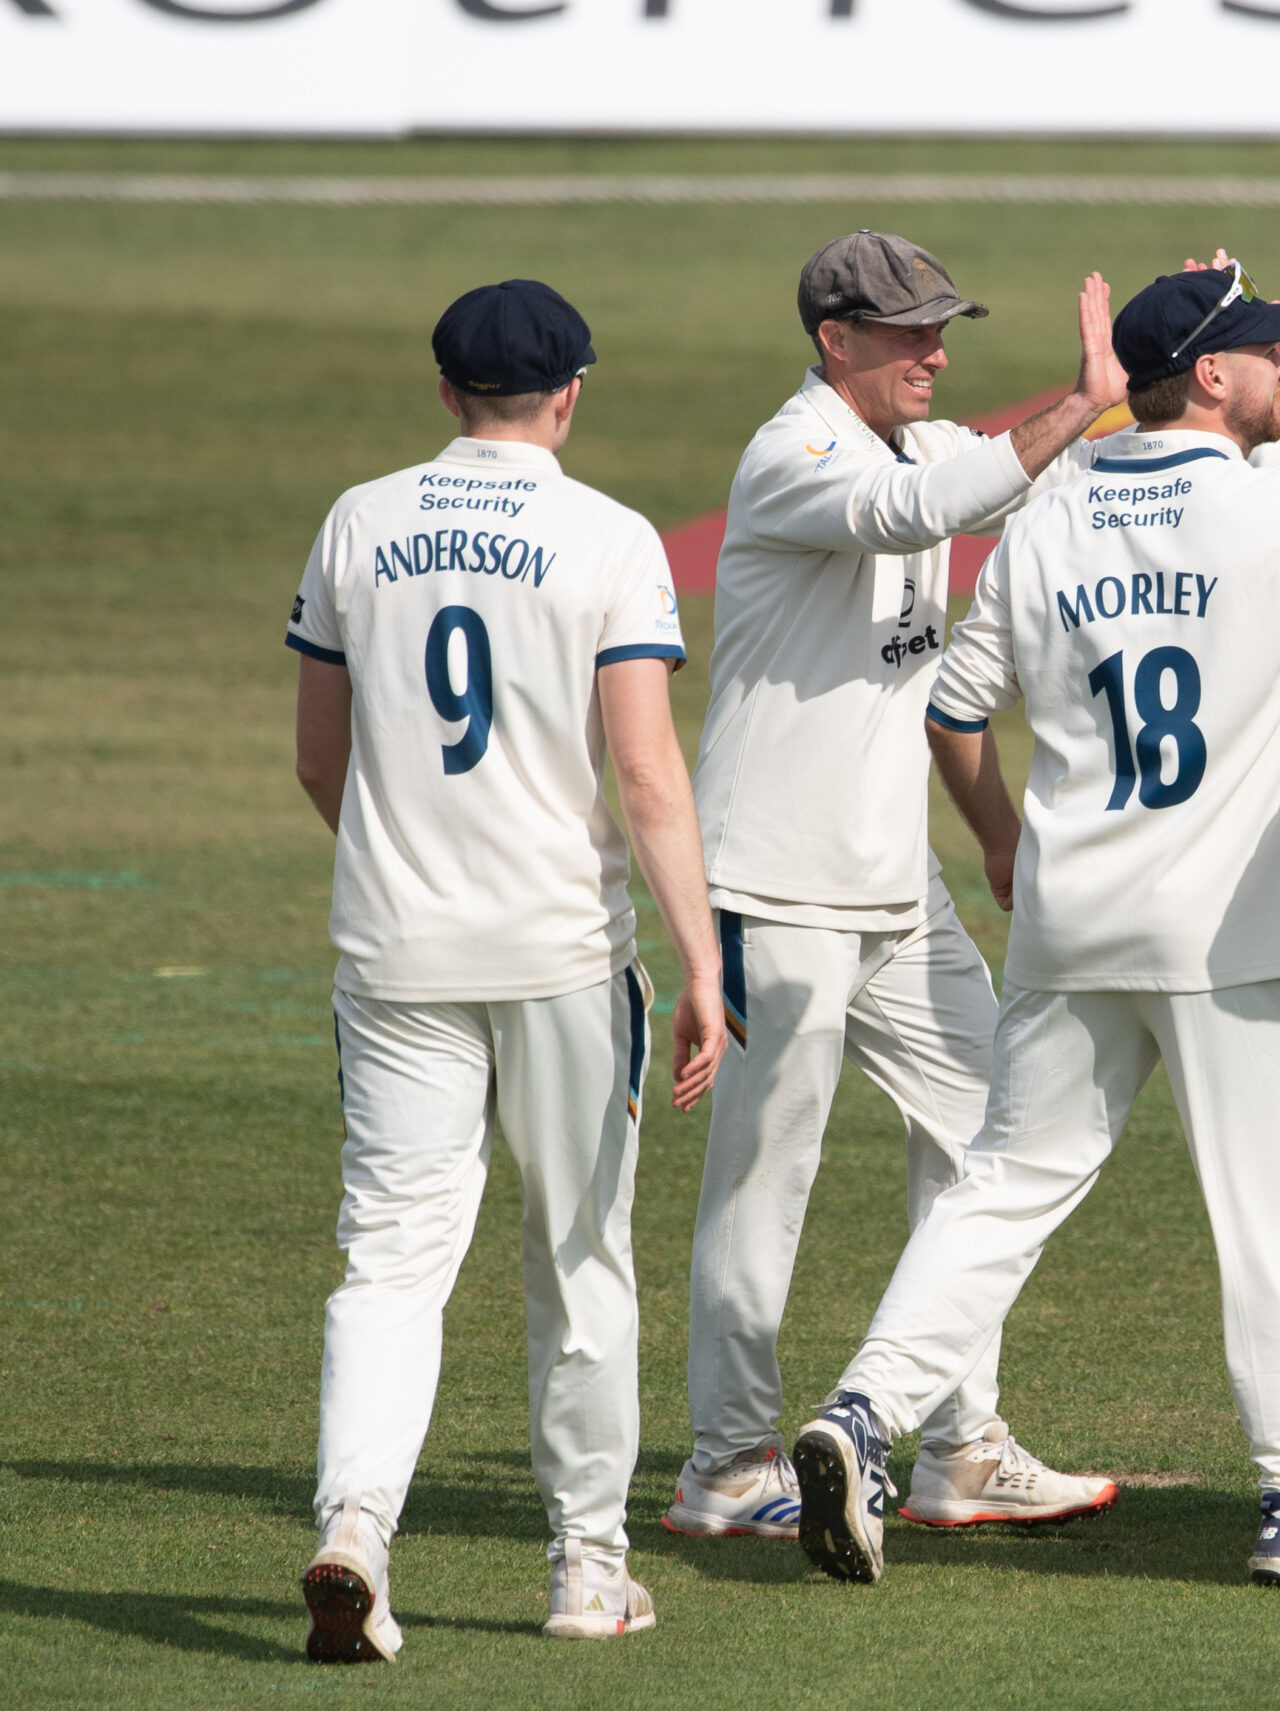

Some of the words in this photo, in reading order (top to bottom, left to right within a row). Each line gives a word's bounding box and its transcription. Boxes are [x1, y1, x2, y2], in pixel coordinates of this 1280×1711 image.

[476, 448, 498, 459] 1870
[1142, 439, 1164, 451] 1870
[418, 474, 537, 492] Keepsafe
[1088, 478, 1193, 506] Keepsafe
[419, 493, 525, 518] Security
[1092, 507, 1184, 530] Security
[375, 529, 557, 588] ANDERSSON
[1056, 571, 1219, 633] MORLEY
[424, 604, 497, 776] 9
[1087, 645, 1208, 812] 18
